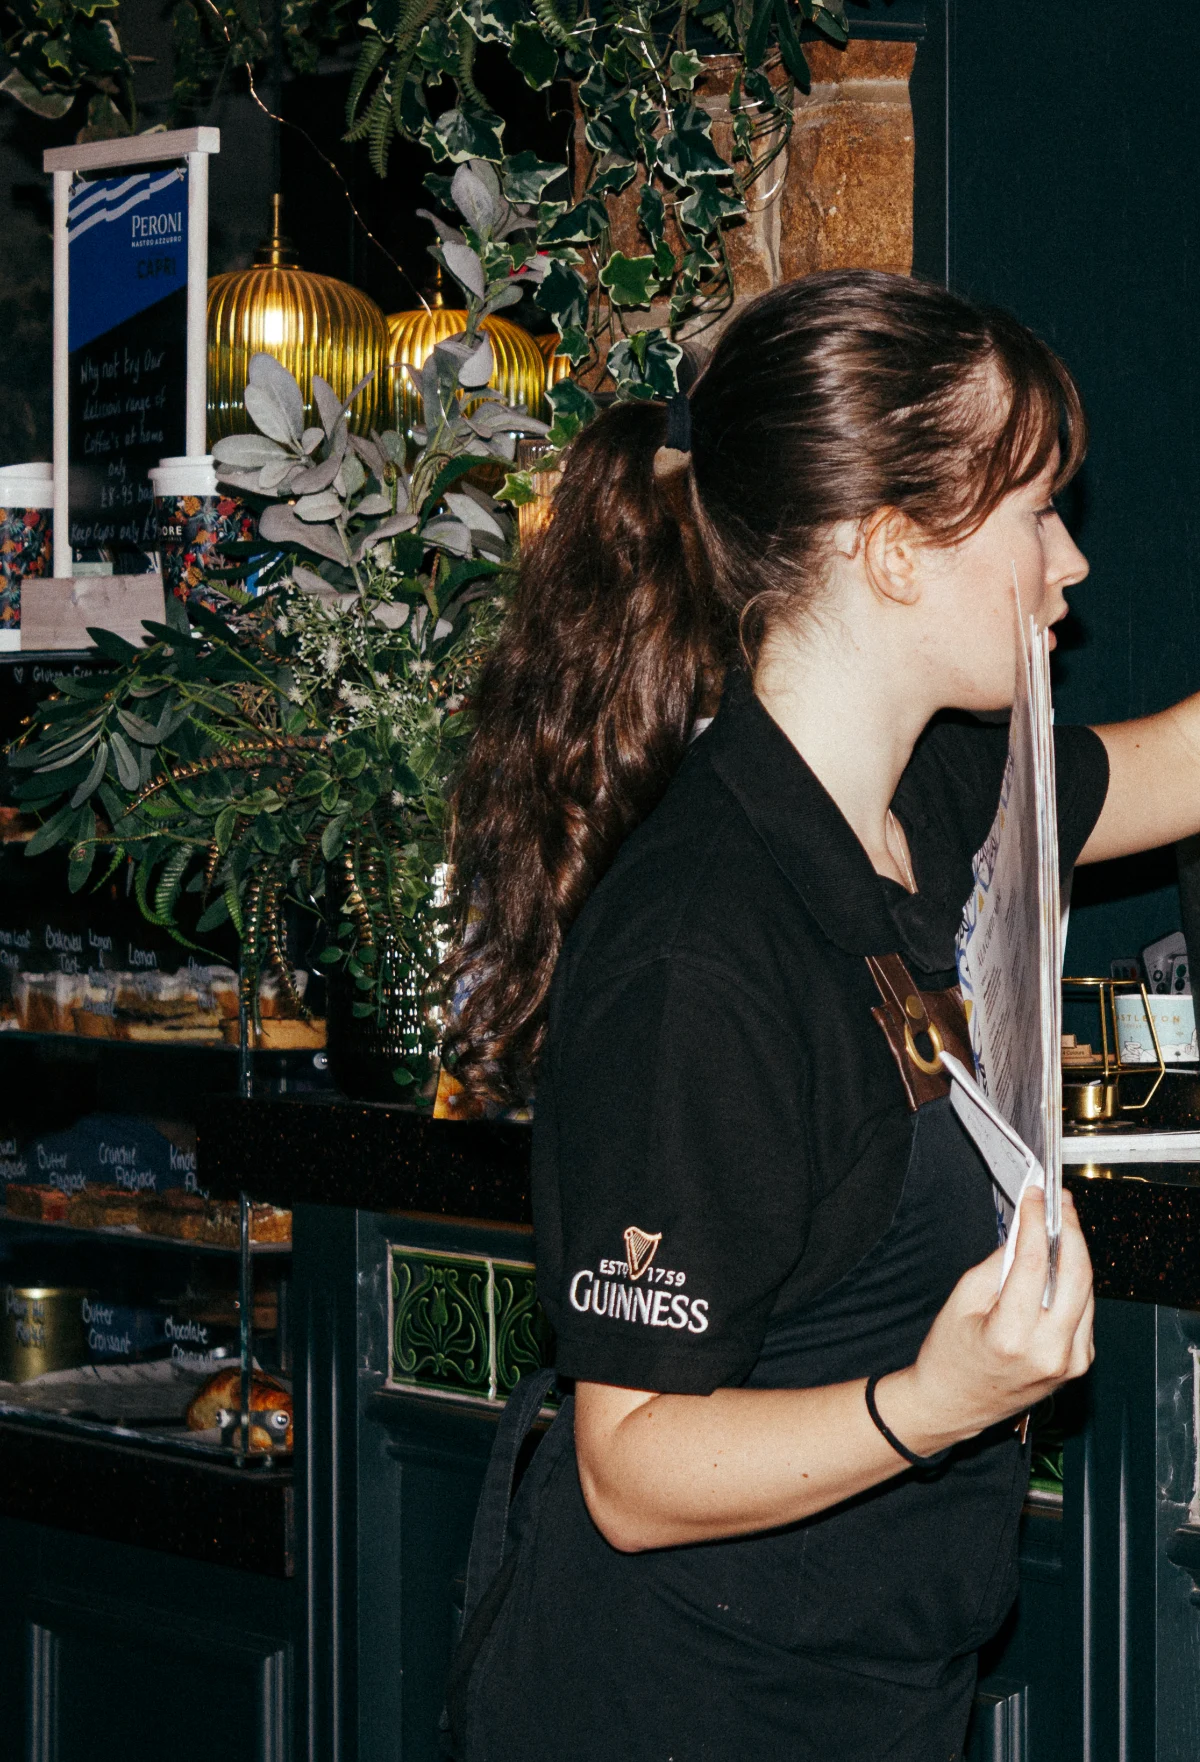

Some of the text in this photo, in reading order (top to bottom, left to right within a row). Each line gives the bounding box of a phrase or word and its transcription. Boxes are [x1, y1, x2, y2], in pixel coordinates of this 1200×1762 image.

[131, 211, 182, 238] PERONI
[131, 235, 183, 248] NASTRO AZZURRO
[137, 257, 176, 279] CAPRI
[80, 356, 100, 396] Why
[102, 351, 120, 379] not
[123, 346, 140, 384] try
[88, 927, 112, 951] Lemon
[128, 942, 157, 967] Lemon
[170, 1144, 197, 1170] Kinde
[115, 1165, 157, 1193] Flapjack
[647, 1266, 686, 1287] 1759
[569, 1269, 709, 1334] GUINNESS
[87, 1328, 132, 1354] Croissant
[164, 1315, 208, 1344] Chocolate
